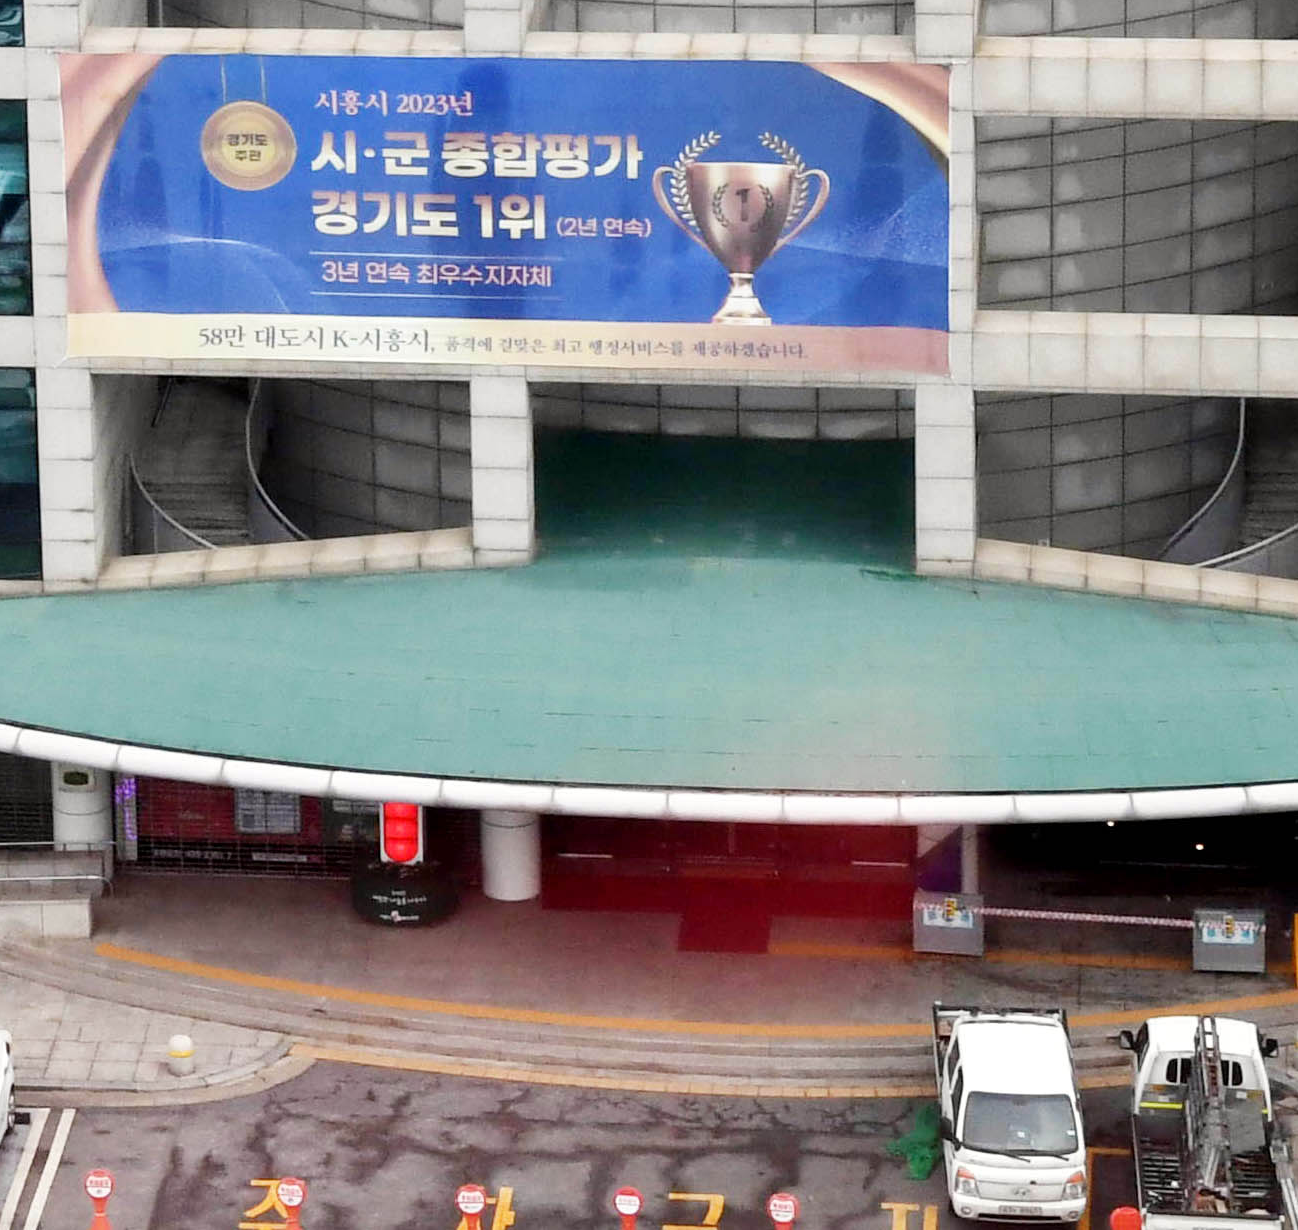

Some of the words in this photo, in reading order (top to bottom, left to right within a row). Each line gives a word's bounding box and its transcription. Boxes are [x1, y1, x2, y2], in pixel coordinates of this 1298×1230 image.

[314, 89, 388, 116] 시흥시
[396, 91, 474, 117] 2023년
[227, 132, 269, 147] 경기도
[440, 131, 644, 181] 종합평가
[311, 190, 460, 238] 경기도
[473, 193, 547, 240] 1위
[555, 216, 598, 239] (2년
[602, 216, 653, 239] 연속)
[321, 260, 359, 284] 3년
[365, 261, 410, 285] 연속
[417, 263, 552, 288] 최우수지자체
[198, 324, 246, 348] 58만
[254, 325, 325, 350] 대도시
[333, 327, 436, 354] K-시흥시,
[552, 338, 584, 355] 최고
